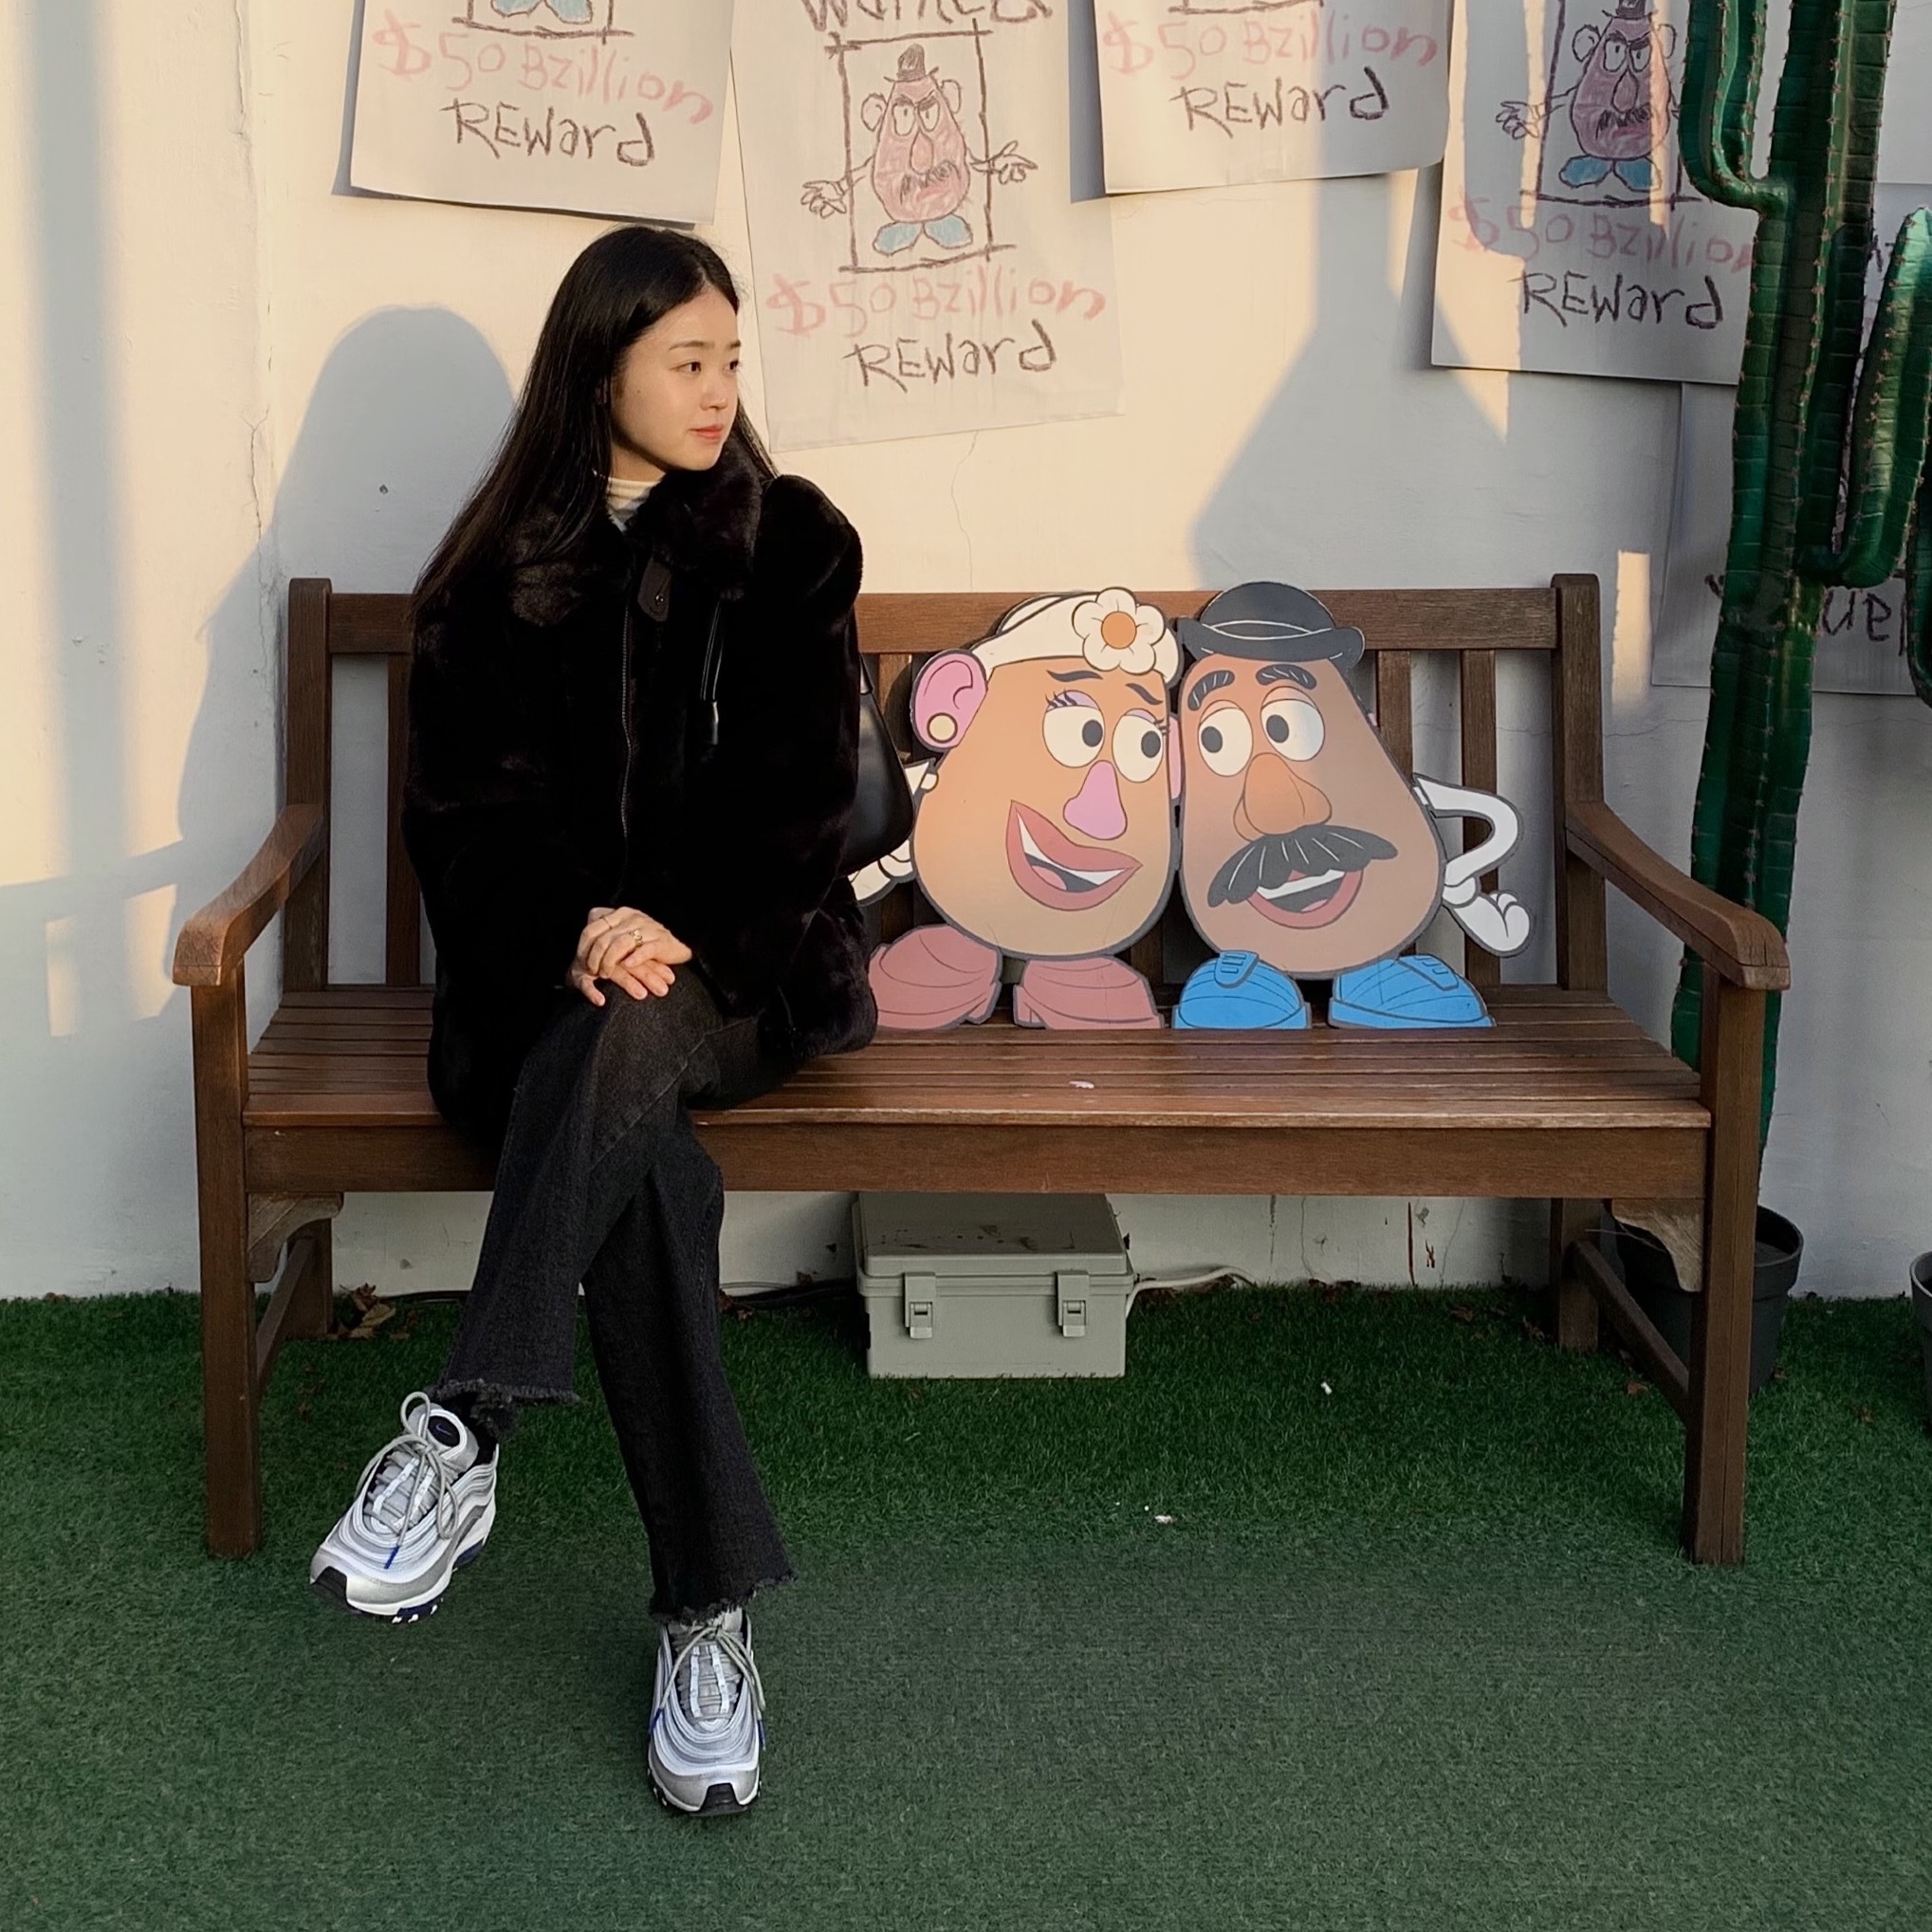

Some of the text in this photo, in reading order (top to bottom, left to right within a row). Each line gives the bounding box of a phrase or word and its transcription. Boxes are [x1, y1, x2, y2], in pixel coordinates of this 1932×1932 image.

[373, 9, 714, 124] $50 Bzillion
[1103, 10, 1228, 81] $50
[1242, 3, 1438, 67] Bzillion
[765, 265, 1107, 338] $50 Bzillion
